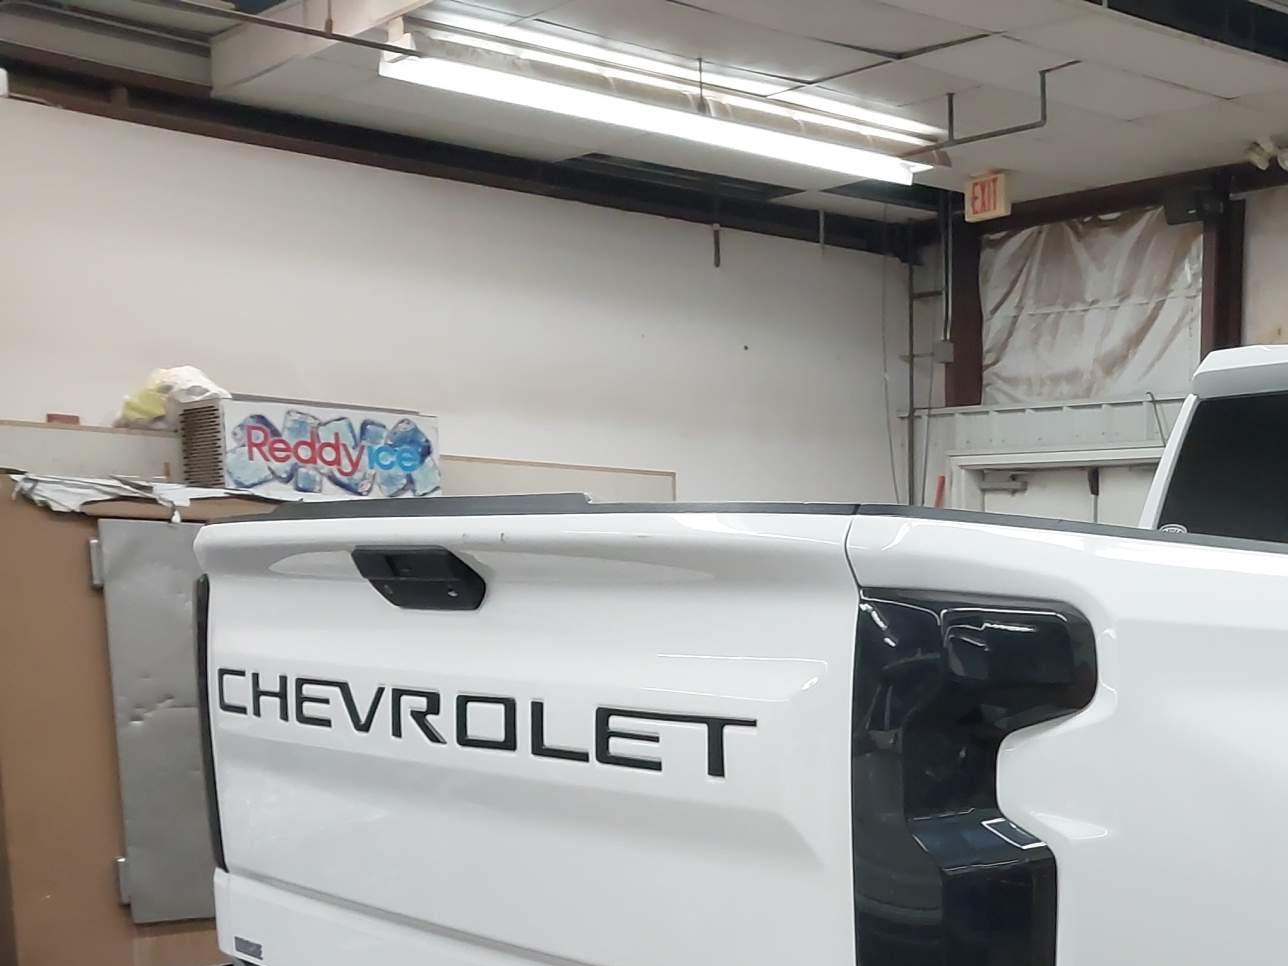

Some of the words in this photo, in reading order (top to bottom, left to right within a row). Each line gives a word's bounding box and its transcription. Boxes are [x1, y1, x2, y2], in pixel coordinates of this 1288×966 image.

[971, 176, 998, 215] EXIT
[245, 424, 364, 477] Reddy
[217, 668, 757, 778] CHEVROLET
